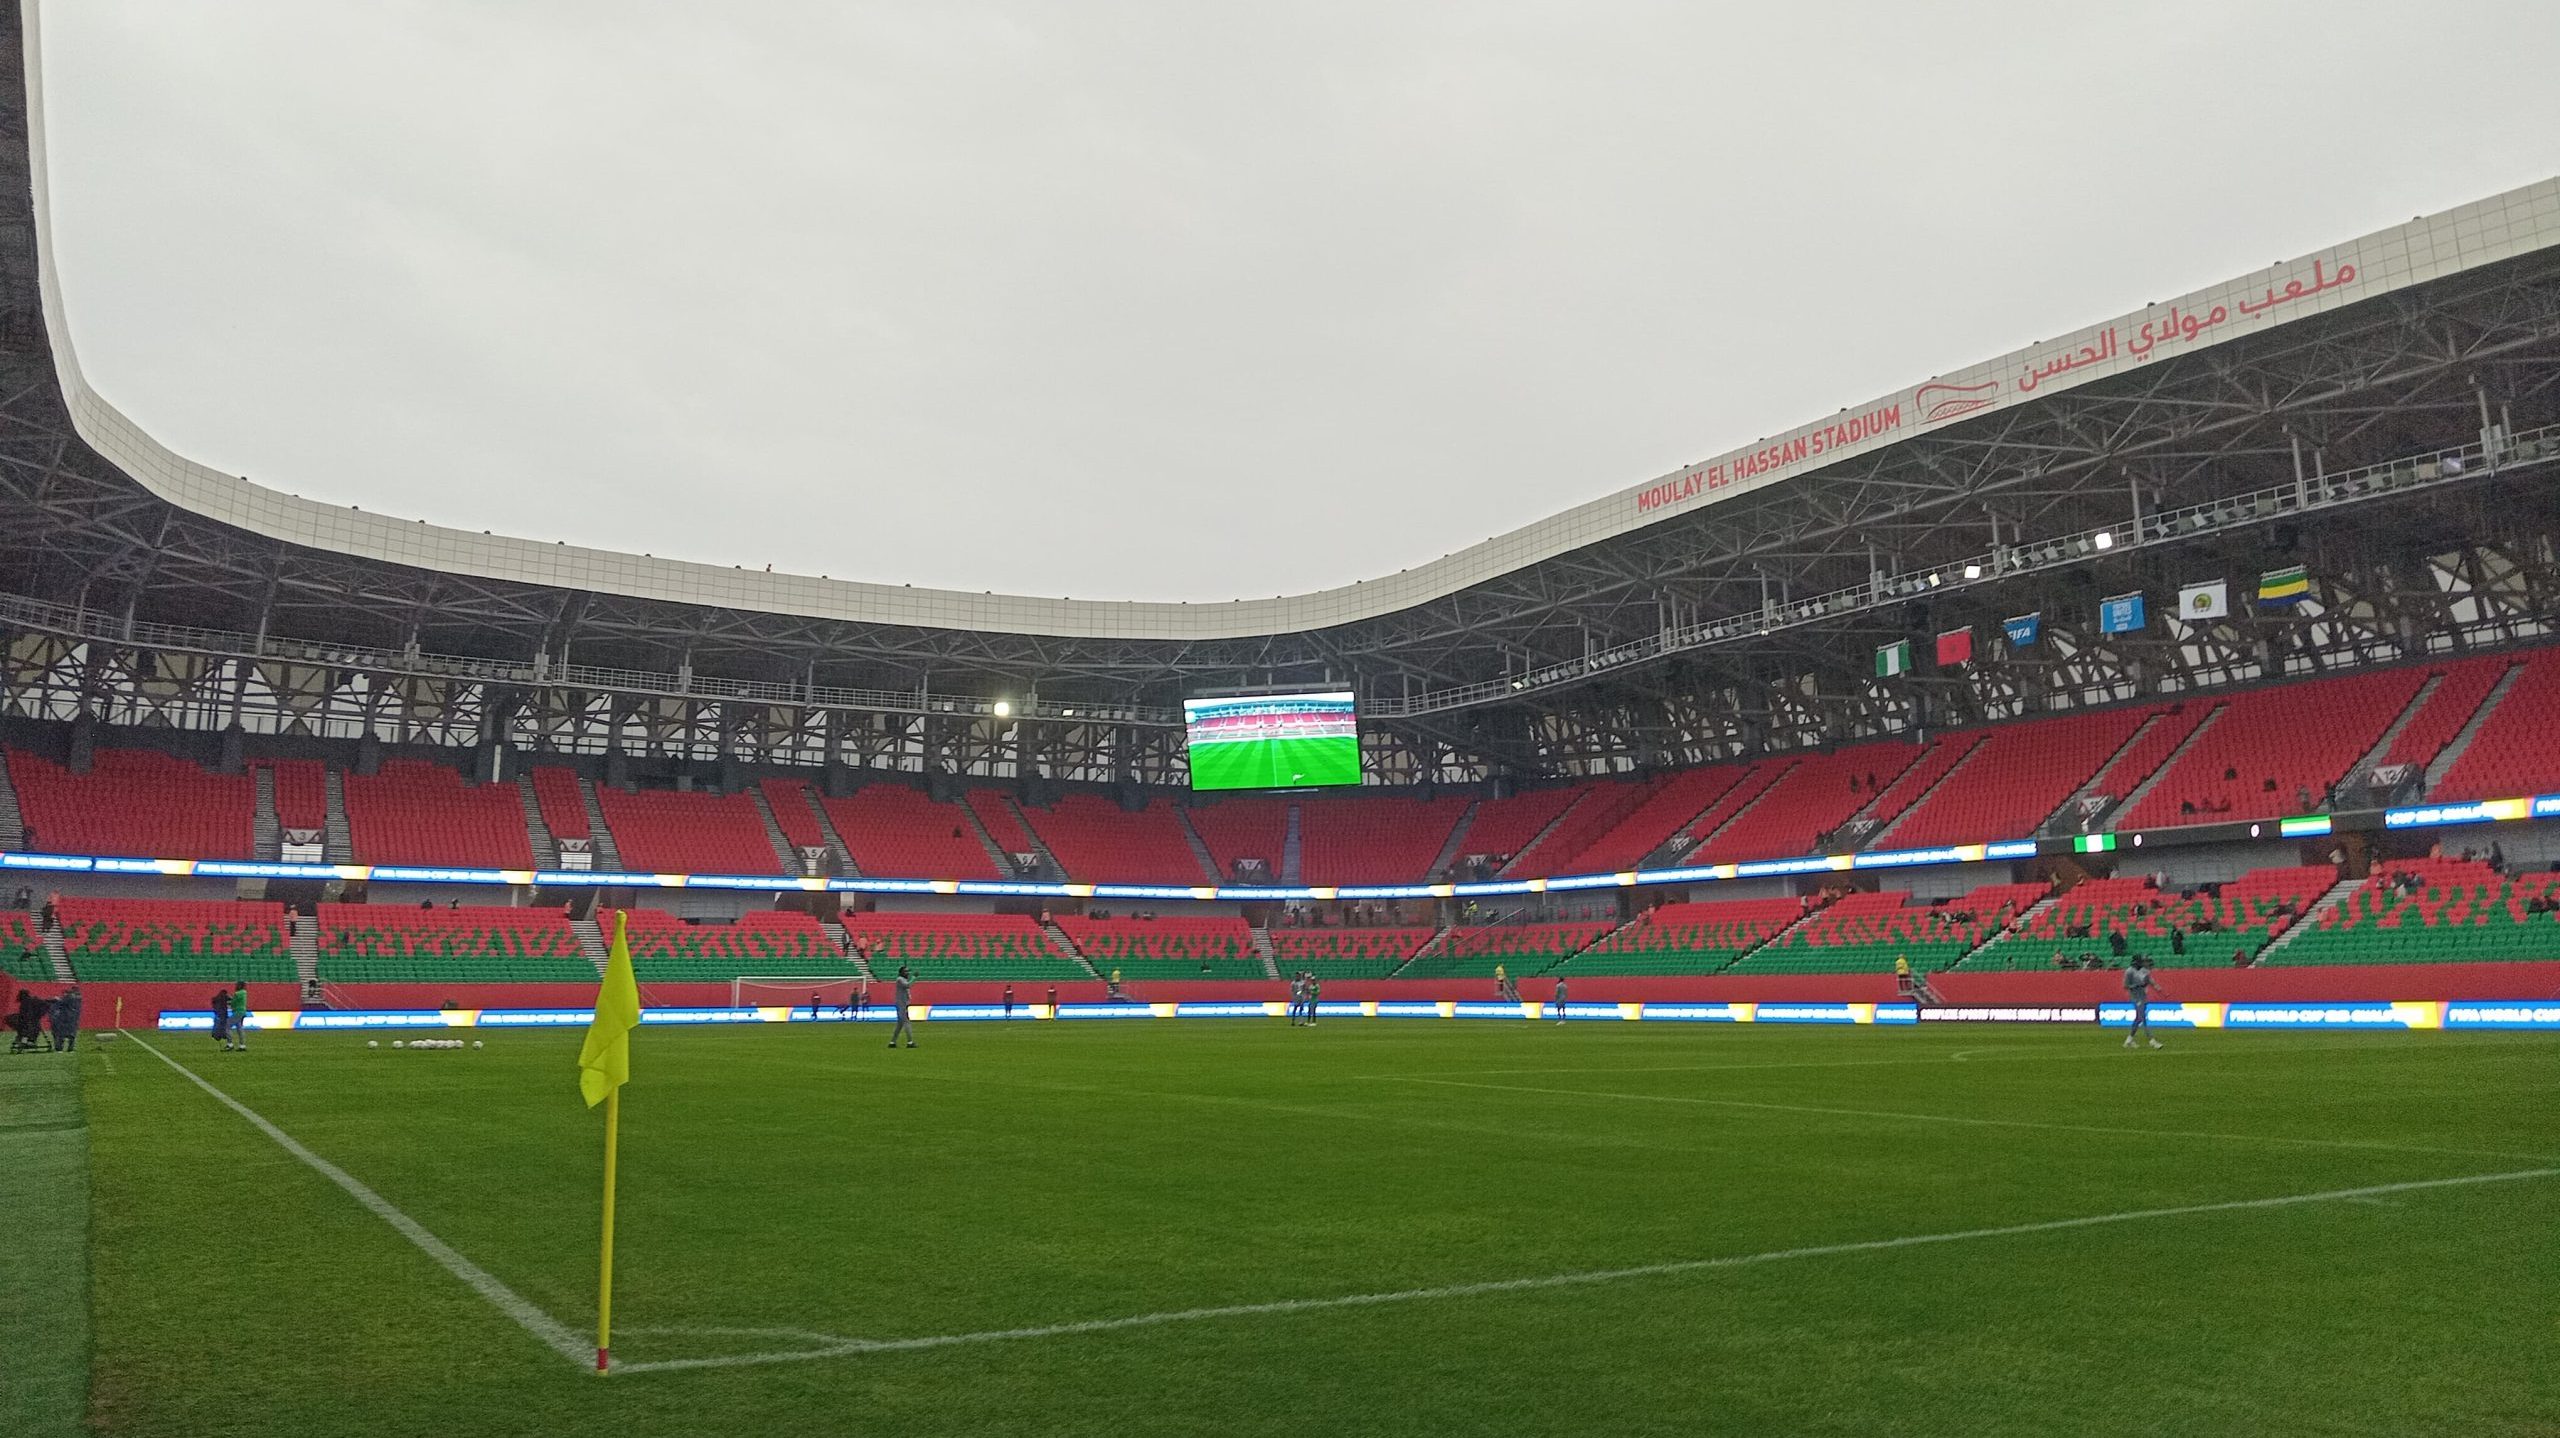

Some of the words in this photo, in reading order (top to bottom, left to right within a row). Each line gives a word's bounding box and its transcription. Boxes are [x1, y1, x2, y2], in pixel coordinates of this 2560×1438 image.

[2239, 259, 2356, 318] ملعب
[2127, 306, 2227, 363] مولاي
[2018, 327, 2117, 392] الحسن
[1637, 472, 1703, 513] MOULAY
[1708, 465, 1729, 489] EL
[1734, 436, 1808, 481] HASSAN
[1812, 404, 1901, 455] STADIUM
[2007, 626, 2031, 640] FIFA
[2384, 769, 2397, 782] 12
[299, 832, 306, 840] 3
[811, 849, 817, 857] 5
